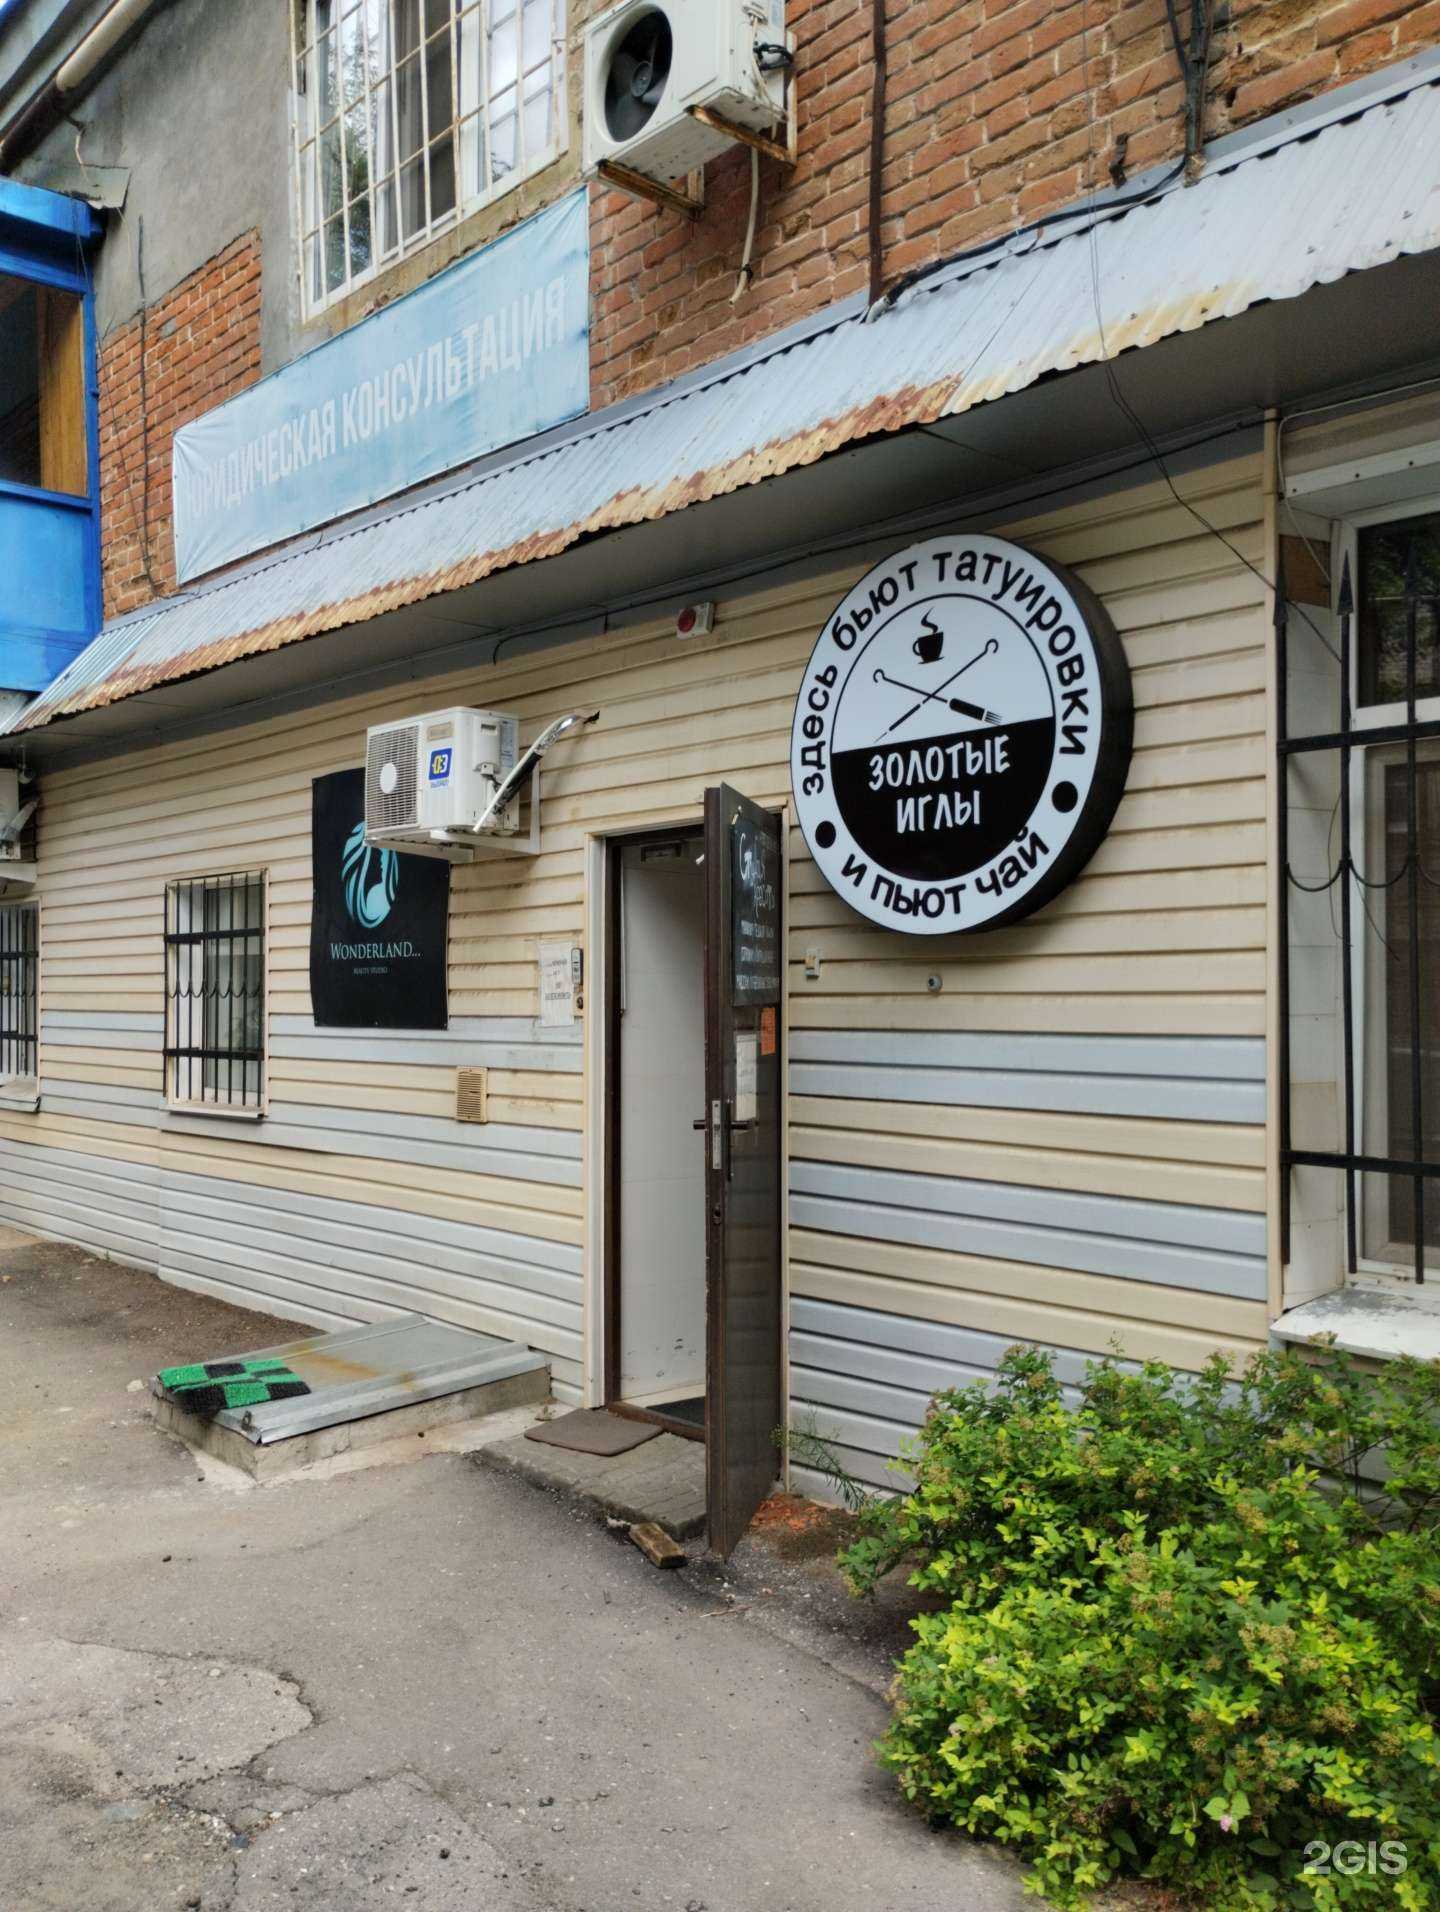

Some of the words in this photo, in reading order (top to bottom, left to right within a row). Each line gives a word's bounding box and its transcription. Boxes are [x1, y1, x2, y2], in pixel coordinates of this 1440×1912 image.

[343, 277, 567, 448] КОНСУЛЬТАЦИЯ
[801, 665, 838, 797] здесь
[832, 560, 919, 652] бьют
[932, 550, 1089, 757] татуировки
[868, 735, 1010, 792] ЗОЛОТЫЕ
[896, 790, 981, 834] ИГЛЫ
[841, 854, 868, 887] и
[870, 874, 967, 919] пьют
[975, 825, 1050, 897] чай
